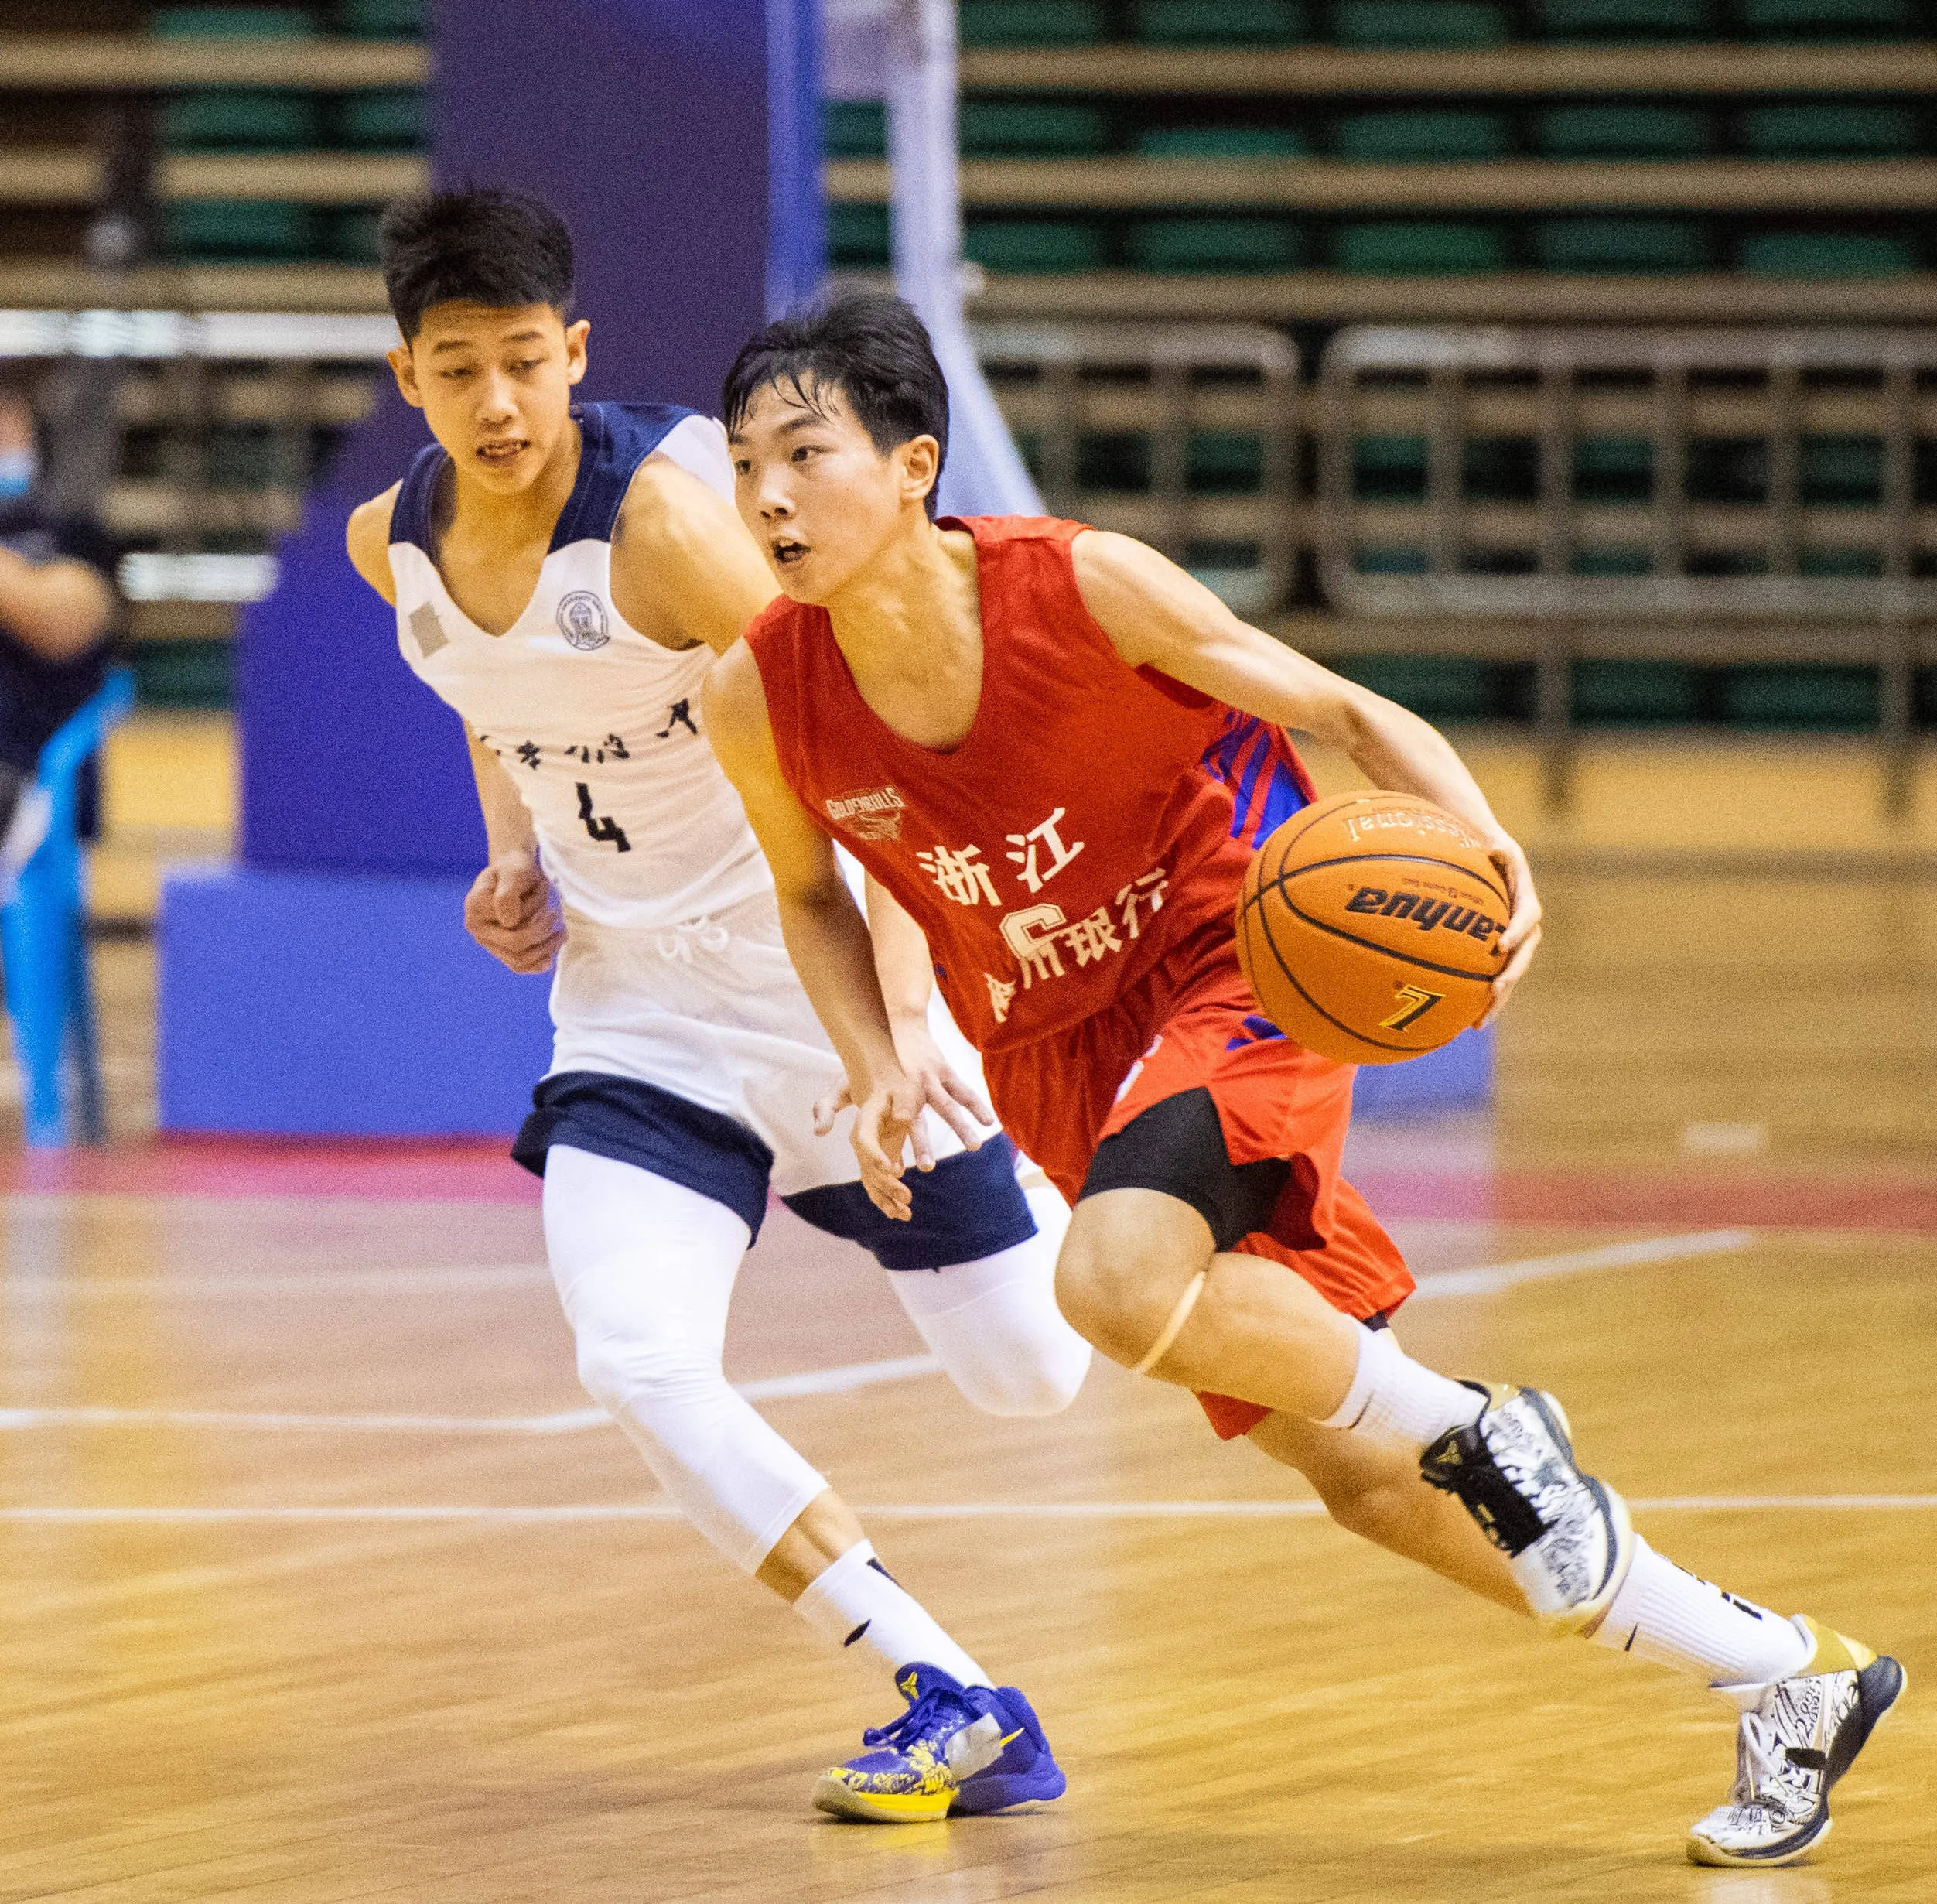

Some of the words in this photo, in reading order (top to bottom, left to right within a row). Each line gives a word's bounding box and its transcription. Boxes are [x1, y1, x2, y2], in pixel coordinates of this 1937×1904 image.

[575, 781, 632, 853] 4
[916, 806, 1085, 907] 浙江
[1378, 983, 1446, 1033] 7
